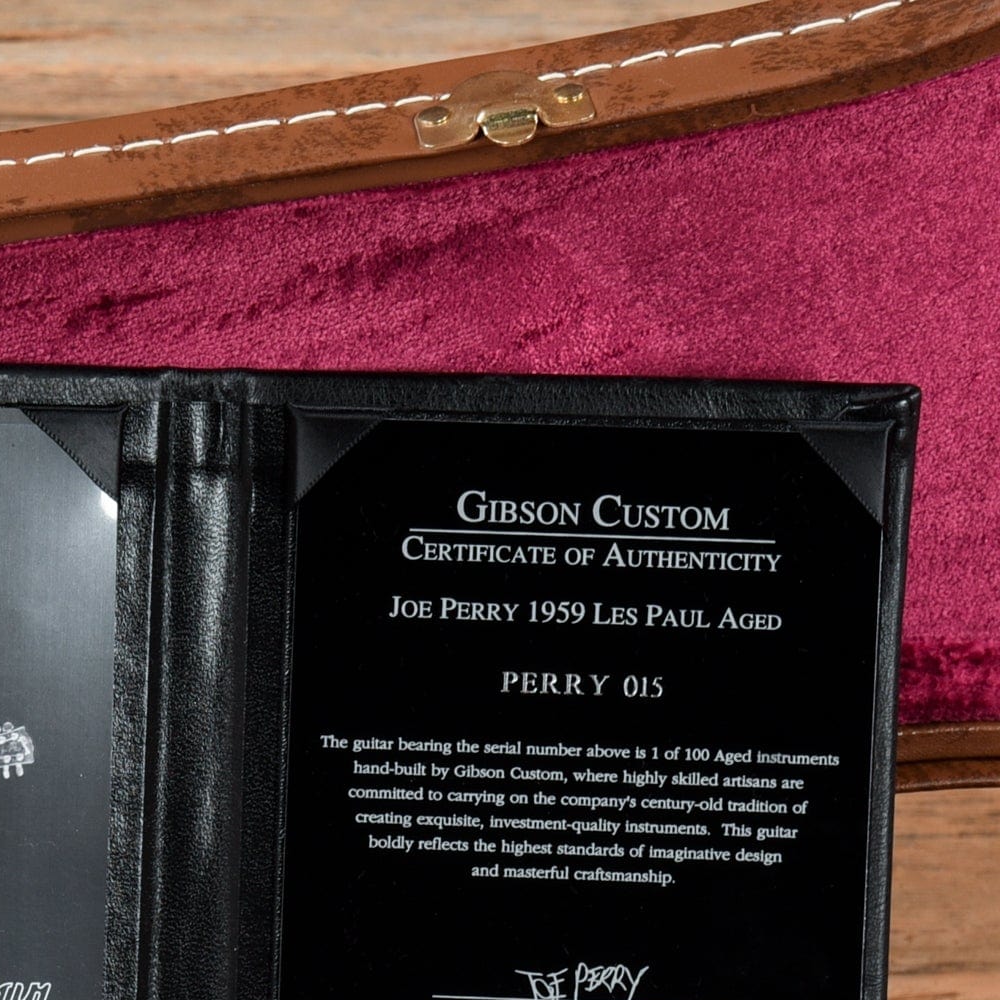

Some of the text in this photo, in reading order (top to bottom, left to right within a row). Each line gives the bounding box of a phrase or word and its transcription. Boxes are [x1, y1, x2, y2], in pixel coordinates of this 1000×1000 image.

[529, 600, 586, 625] 1959
[500, 671, 663, 698] PERRY 015
[319, 734, 840, 766] The guitar bearing the serial number above is 1 of 100 Aged instruments
[471, 863, 676, 888] and masterful craftsmanship.
